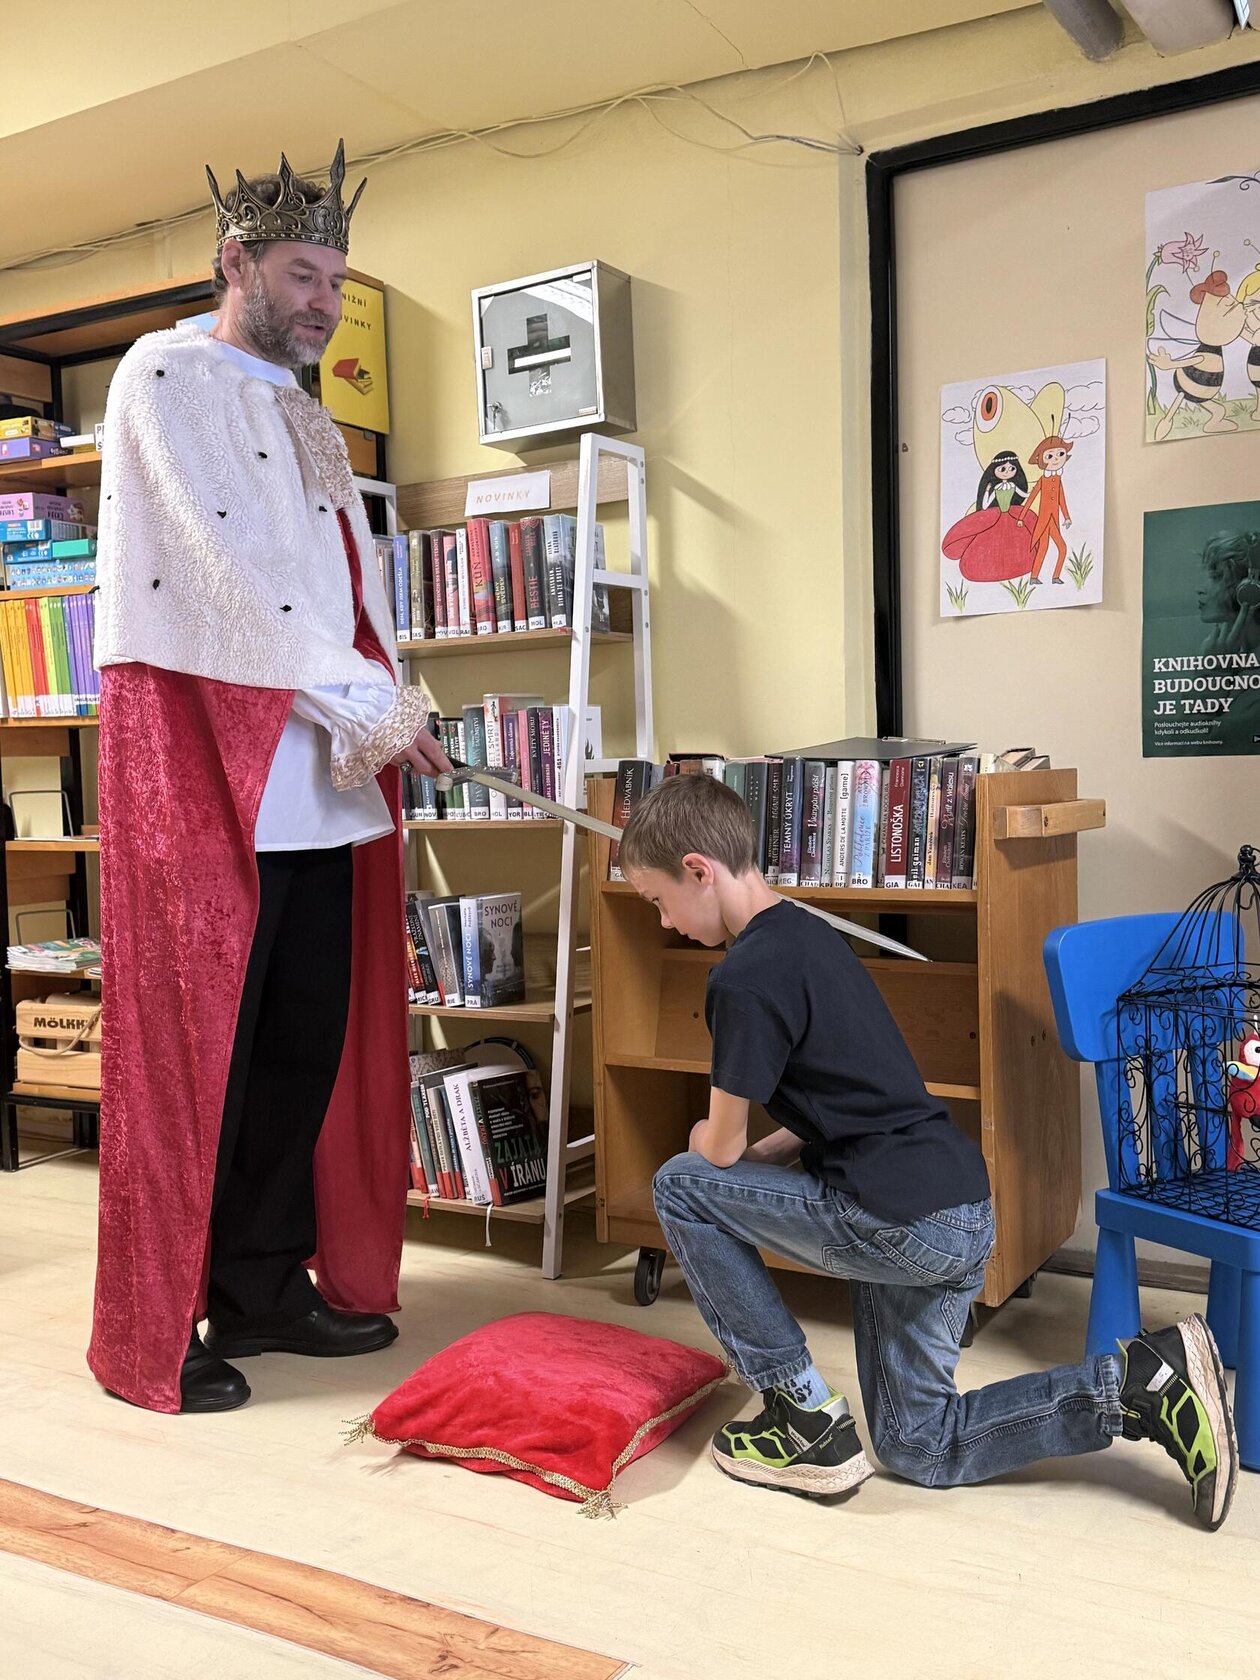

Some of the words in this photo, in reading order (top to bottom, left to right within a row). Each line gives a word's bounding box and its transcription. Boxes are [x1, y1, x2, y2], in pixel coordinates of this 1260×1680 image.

[342, 292, 367, 307] NIŽNÍ
[344, 315, 371, 331] VINKY
[476, 490, 531, 504] NOVINKY
[529, 576, 539, 609] BESTIE
[1153, 653, 1260, 673] KNIHOVNA
[1153, 700, 1176, 715] JE
[1180, 698, 1234, 714] TADY
[541, 719, 549, 729] TY
[621, 767, 634, 819] HEDVÁBNÍK
[840, 773, 849, 800] [game]
[946, 772, 954, 797] Walesu
[784, 791, 793, 820] ÚKRYT
[807, 794, 819, 827] Vikingův
[771, 829, 779, 863] AICHNER
[783, 822, 791, 853] TEMNÝ
[890, 804, 904, 862] LISTONOŠKA
[912, 837, 922, 866] gaiman
[484, 900, 518, 917] SYNOVÉ
[490, 916, 513, 929] NOCI
[466, 956, 474, 989] SYNOVÉ
[33, 1016, 97, 1030] MÖLKK
[453, 1083, 463, 1106] DRAK
[458, 1116, 472, 1151] ALŽBĚTA
[499, 1166, 509, 1190] V
[511, 1158, 546, 1188] ÍRÁNU
